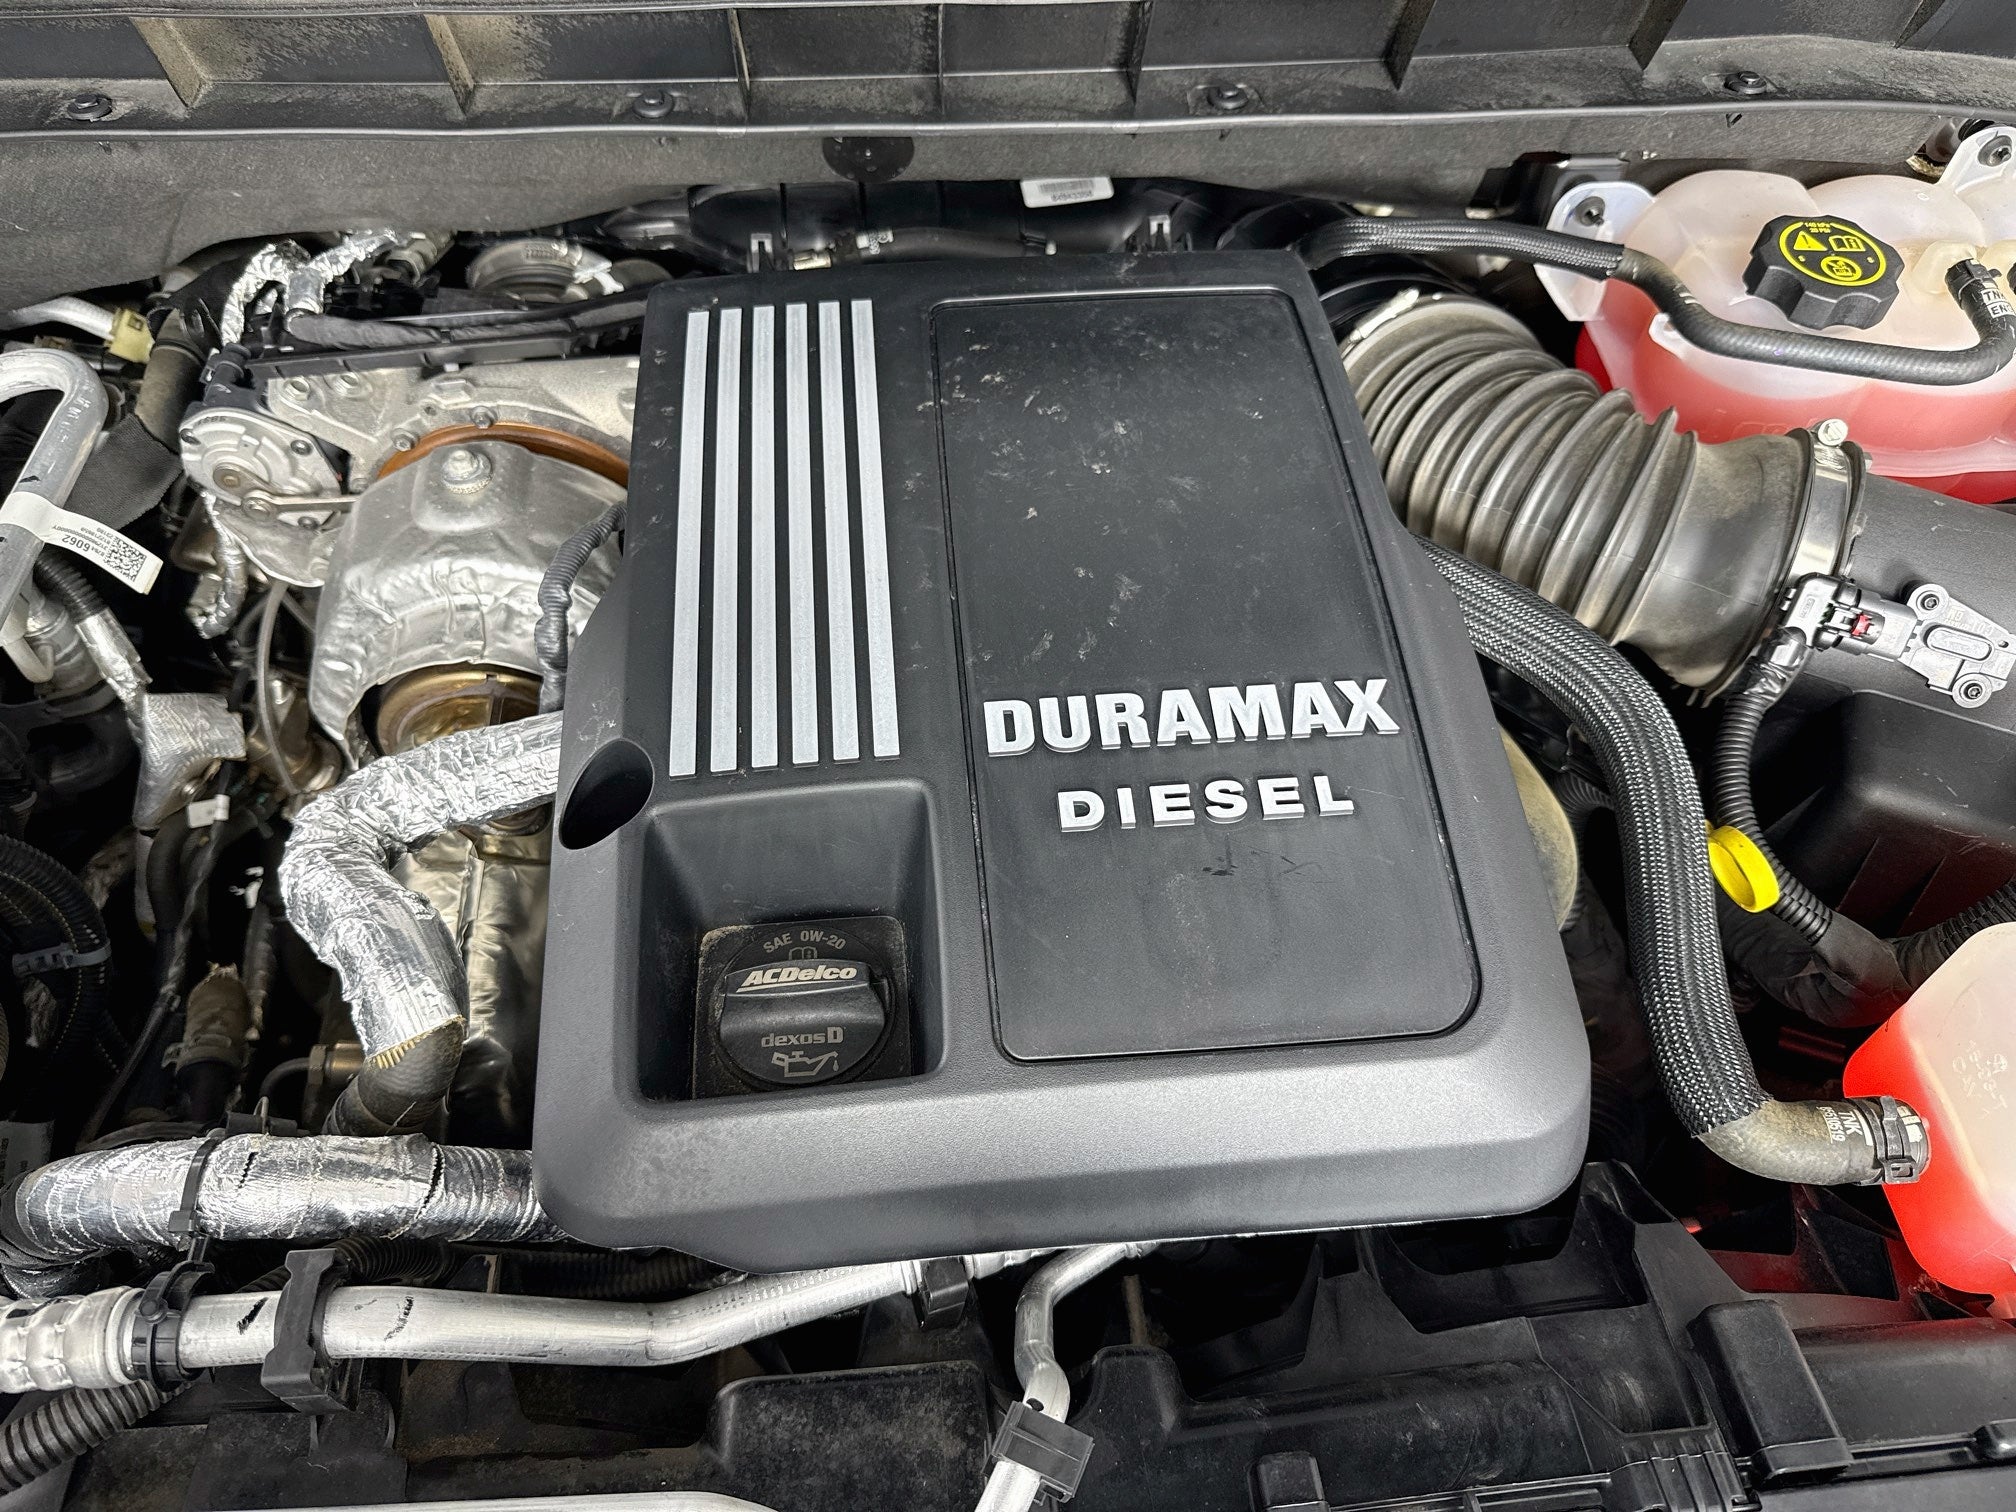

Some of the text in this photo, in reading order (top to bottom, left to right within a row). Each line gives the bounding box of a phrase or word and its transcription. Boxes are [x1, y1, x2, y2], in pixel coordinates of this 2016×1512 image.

[62, 534, 90, 552] 6062
[983, 679, 1400, 757] DURAMAX
[1057, 776, 1354, 832] DIESEL
[763, 930, 846, 953] SAE 0W-20
[741, 965, 857, 987] ACDelco
[1838, 1109, 1863, 1136] TNK
